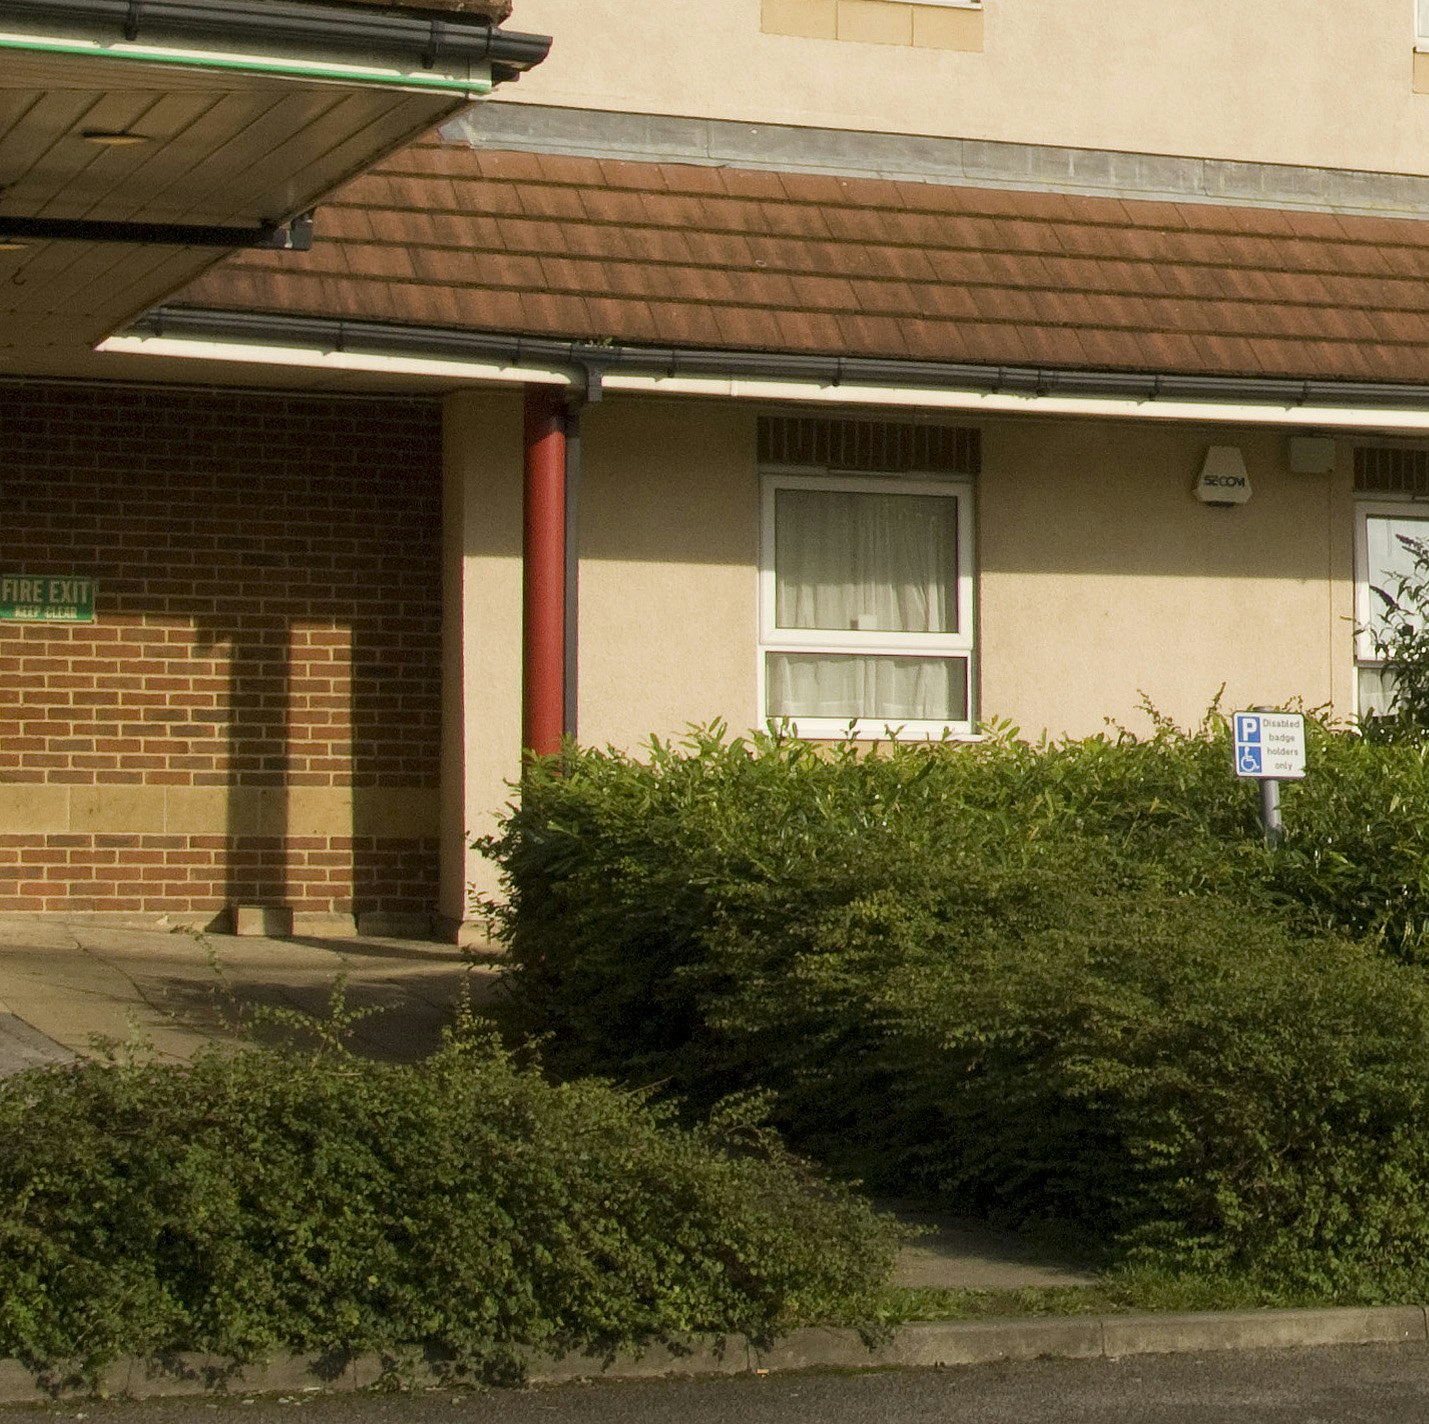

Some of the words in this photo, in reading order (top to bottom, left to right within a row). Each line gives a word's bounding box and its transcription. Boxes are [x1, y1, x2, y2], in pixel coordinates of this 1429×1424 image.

[1204, 476, 1246, 487] SECOM
[3, 578, 44, 602] FIRE
[49, 579, 91, 604] EXIT
[1263, 719, 1300, 728] Disabled
[1243, 719, 1257, 742] P
[1269, 735, 1296, 743] badge
[1267, 748, 1299, 756] holders
[1275, 763, 1293, 771] only
